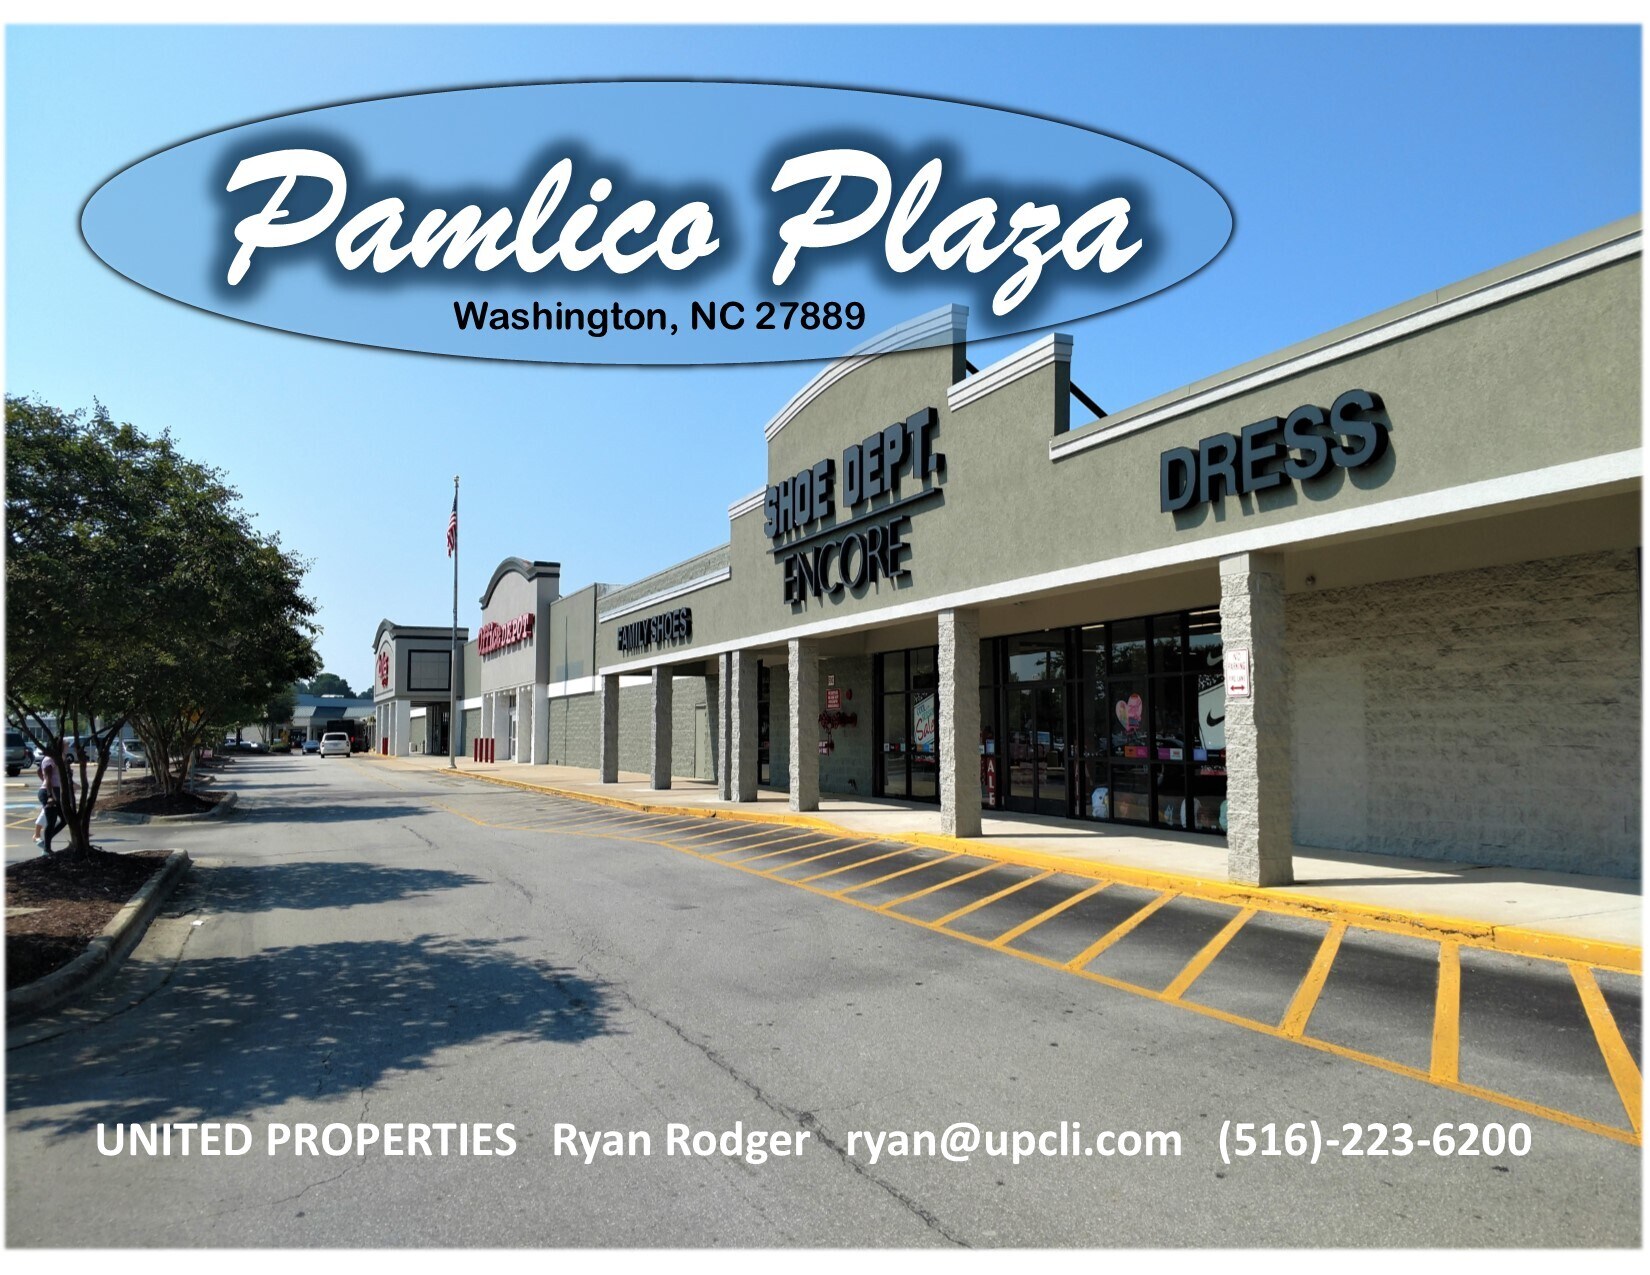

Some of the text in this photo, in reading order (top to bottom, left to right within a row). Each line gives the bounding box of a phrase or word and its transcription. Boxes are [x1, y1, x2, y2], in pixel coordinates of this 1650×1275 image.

[764, 406, 946, 539] SHOE DEPT.
[1160, 388, 1388, 514] DRESS
[783, 515, 911, 604] ENCORE
[617, 606, 693, 651] FAMILY SHOES
[987, 759, 997, 807] ALE
